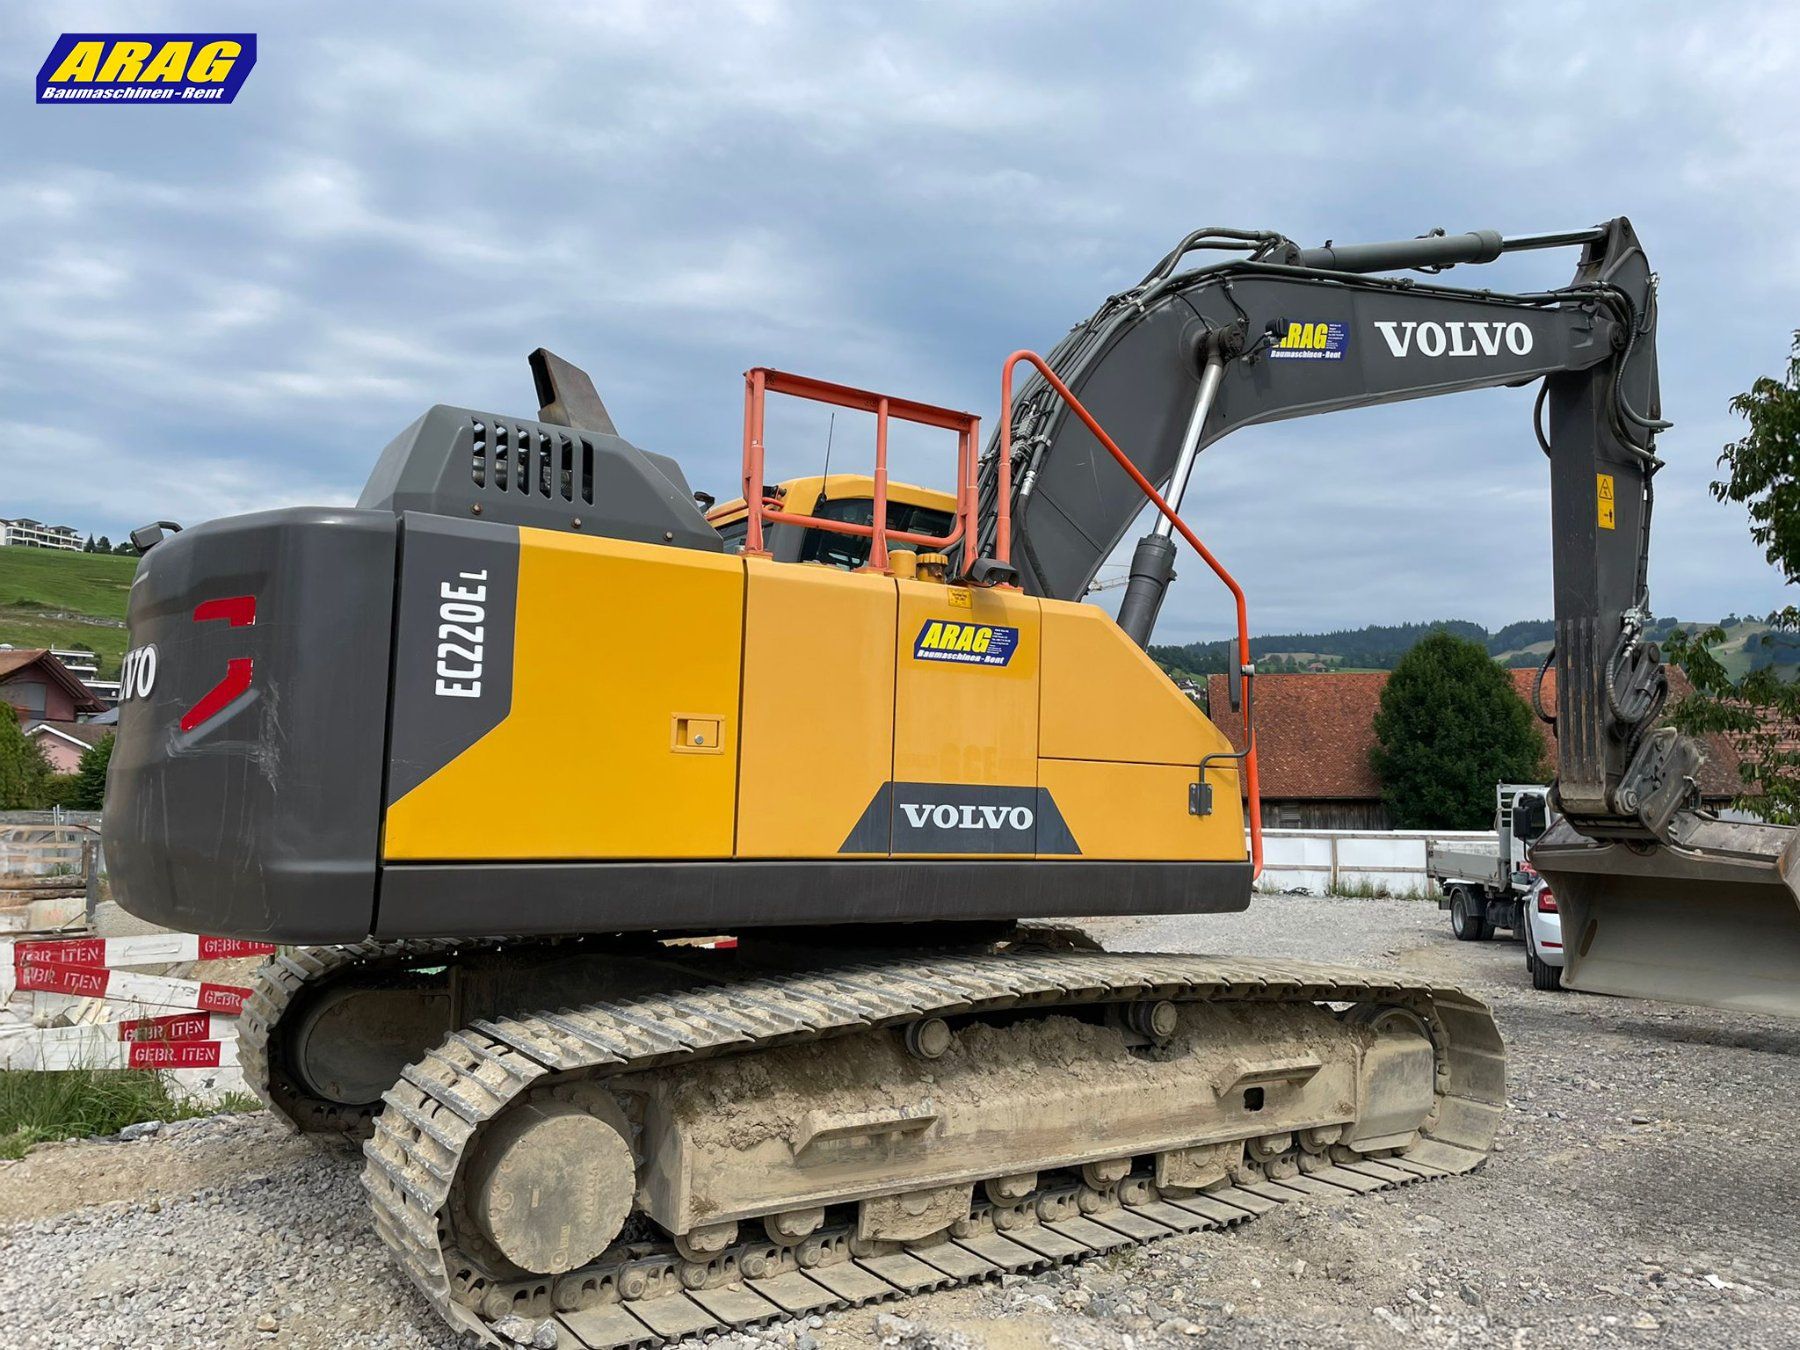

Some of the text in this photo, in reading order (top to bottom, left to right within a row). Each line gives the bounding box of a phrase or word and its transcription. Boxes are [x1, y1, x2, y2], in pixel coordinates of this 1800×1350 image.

[1374, 321, 1534, 357] VOLVO
[920, 622, 993, 653] ARAG
[900, 803, 1034, 831] VOLVO
[61, 947, 99, 963] ITEN
[63, 972, 102, 990] ITEN
[124, 1019, 205, 1041] GBR ITEN
[135, 1047, 216, 1062] GEBR. ITEN
